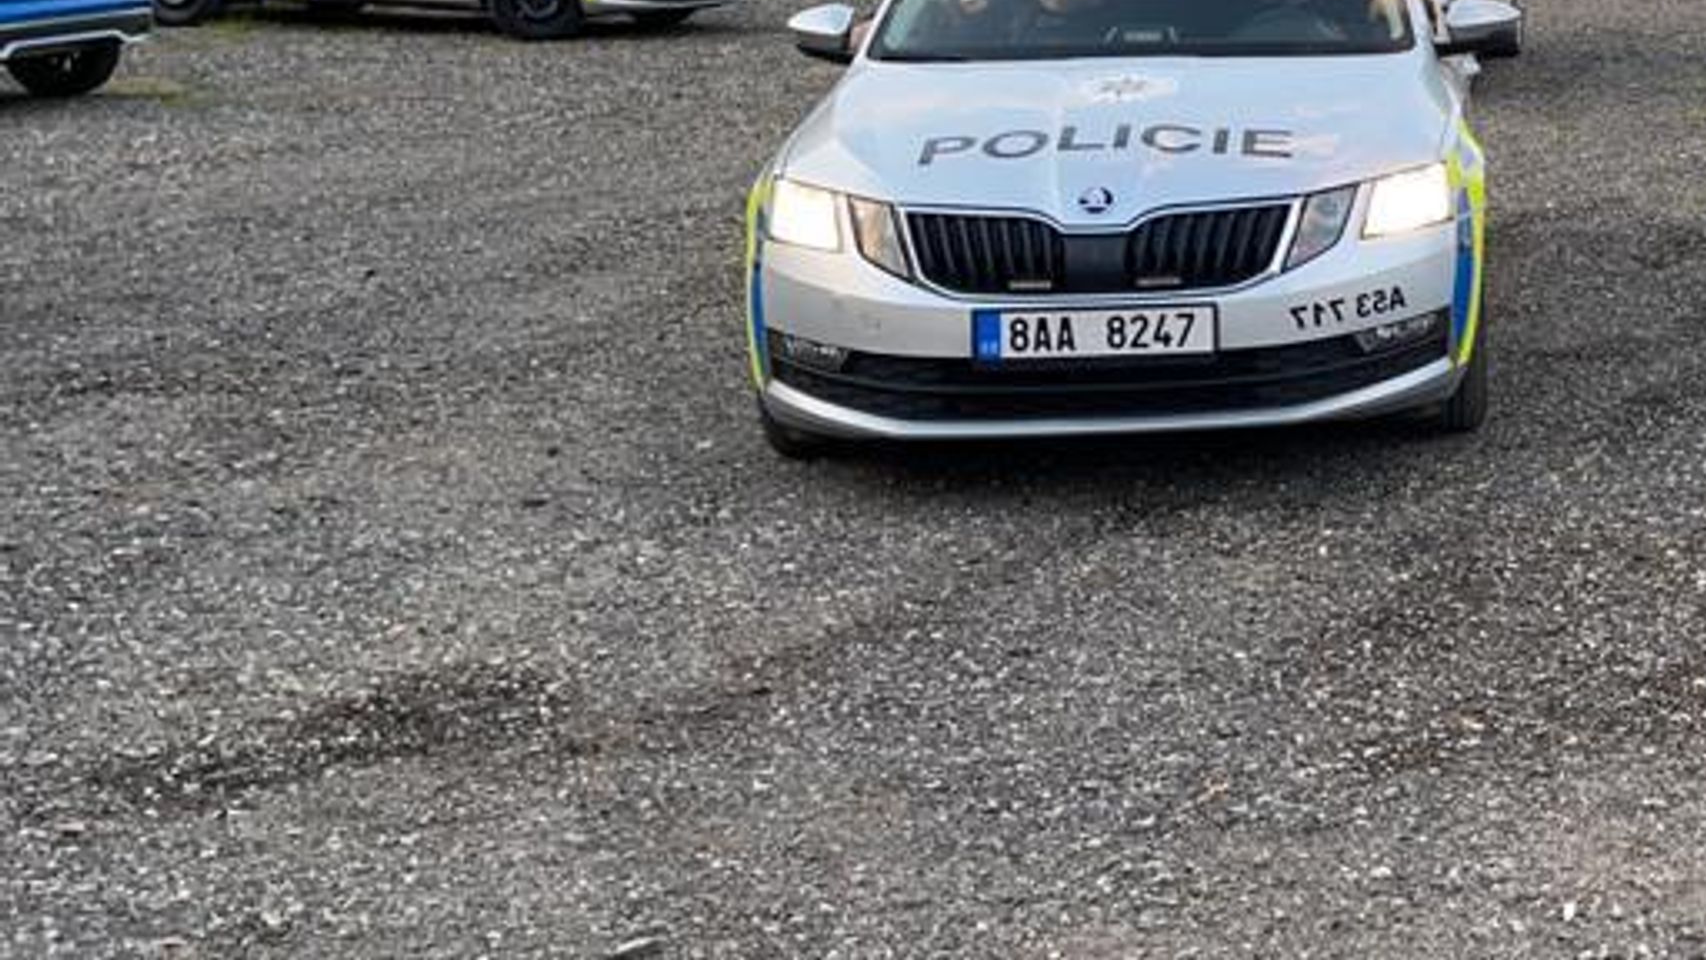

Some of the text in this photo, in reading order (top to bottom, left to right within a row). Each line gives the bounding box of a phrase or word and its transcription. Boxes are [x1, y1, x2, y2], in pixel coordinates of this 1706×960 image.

[917, 124, 1294, 165] POLICIE
[1009, 316, 1075, 352] 8AA
[1106, 313, 1196, 349] 8247
